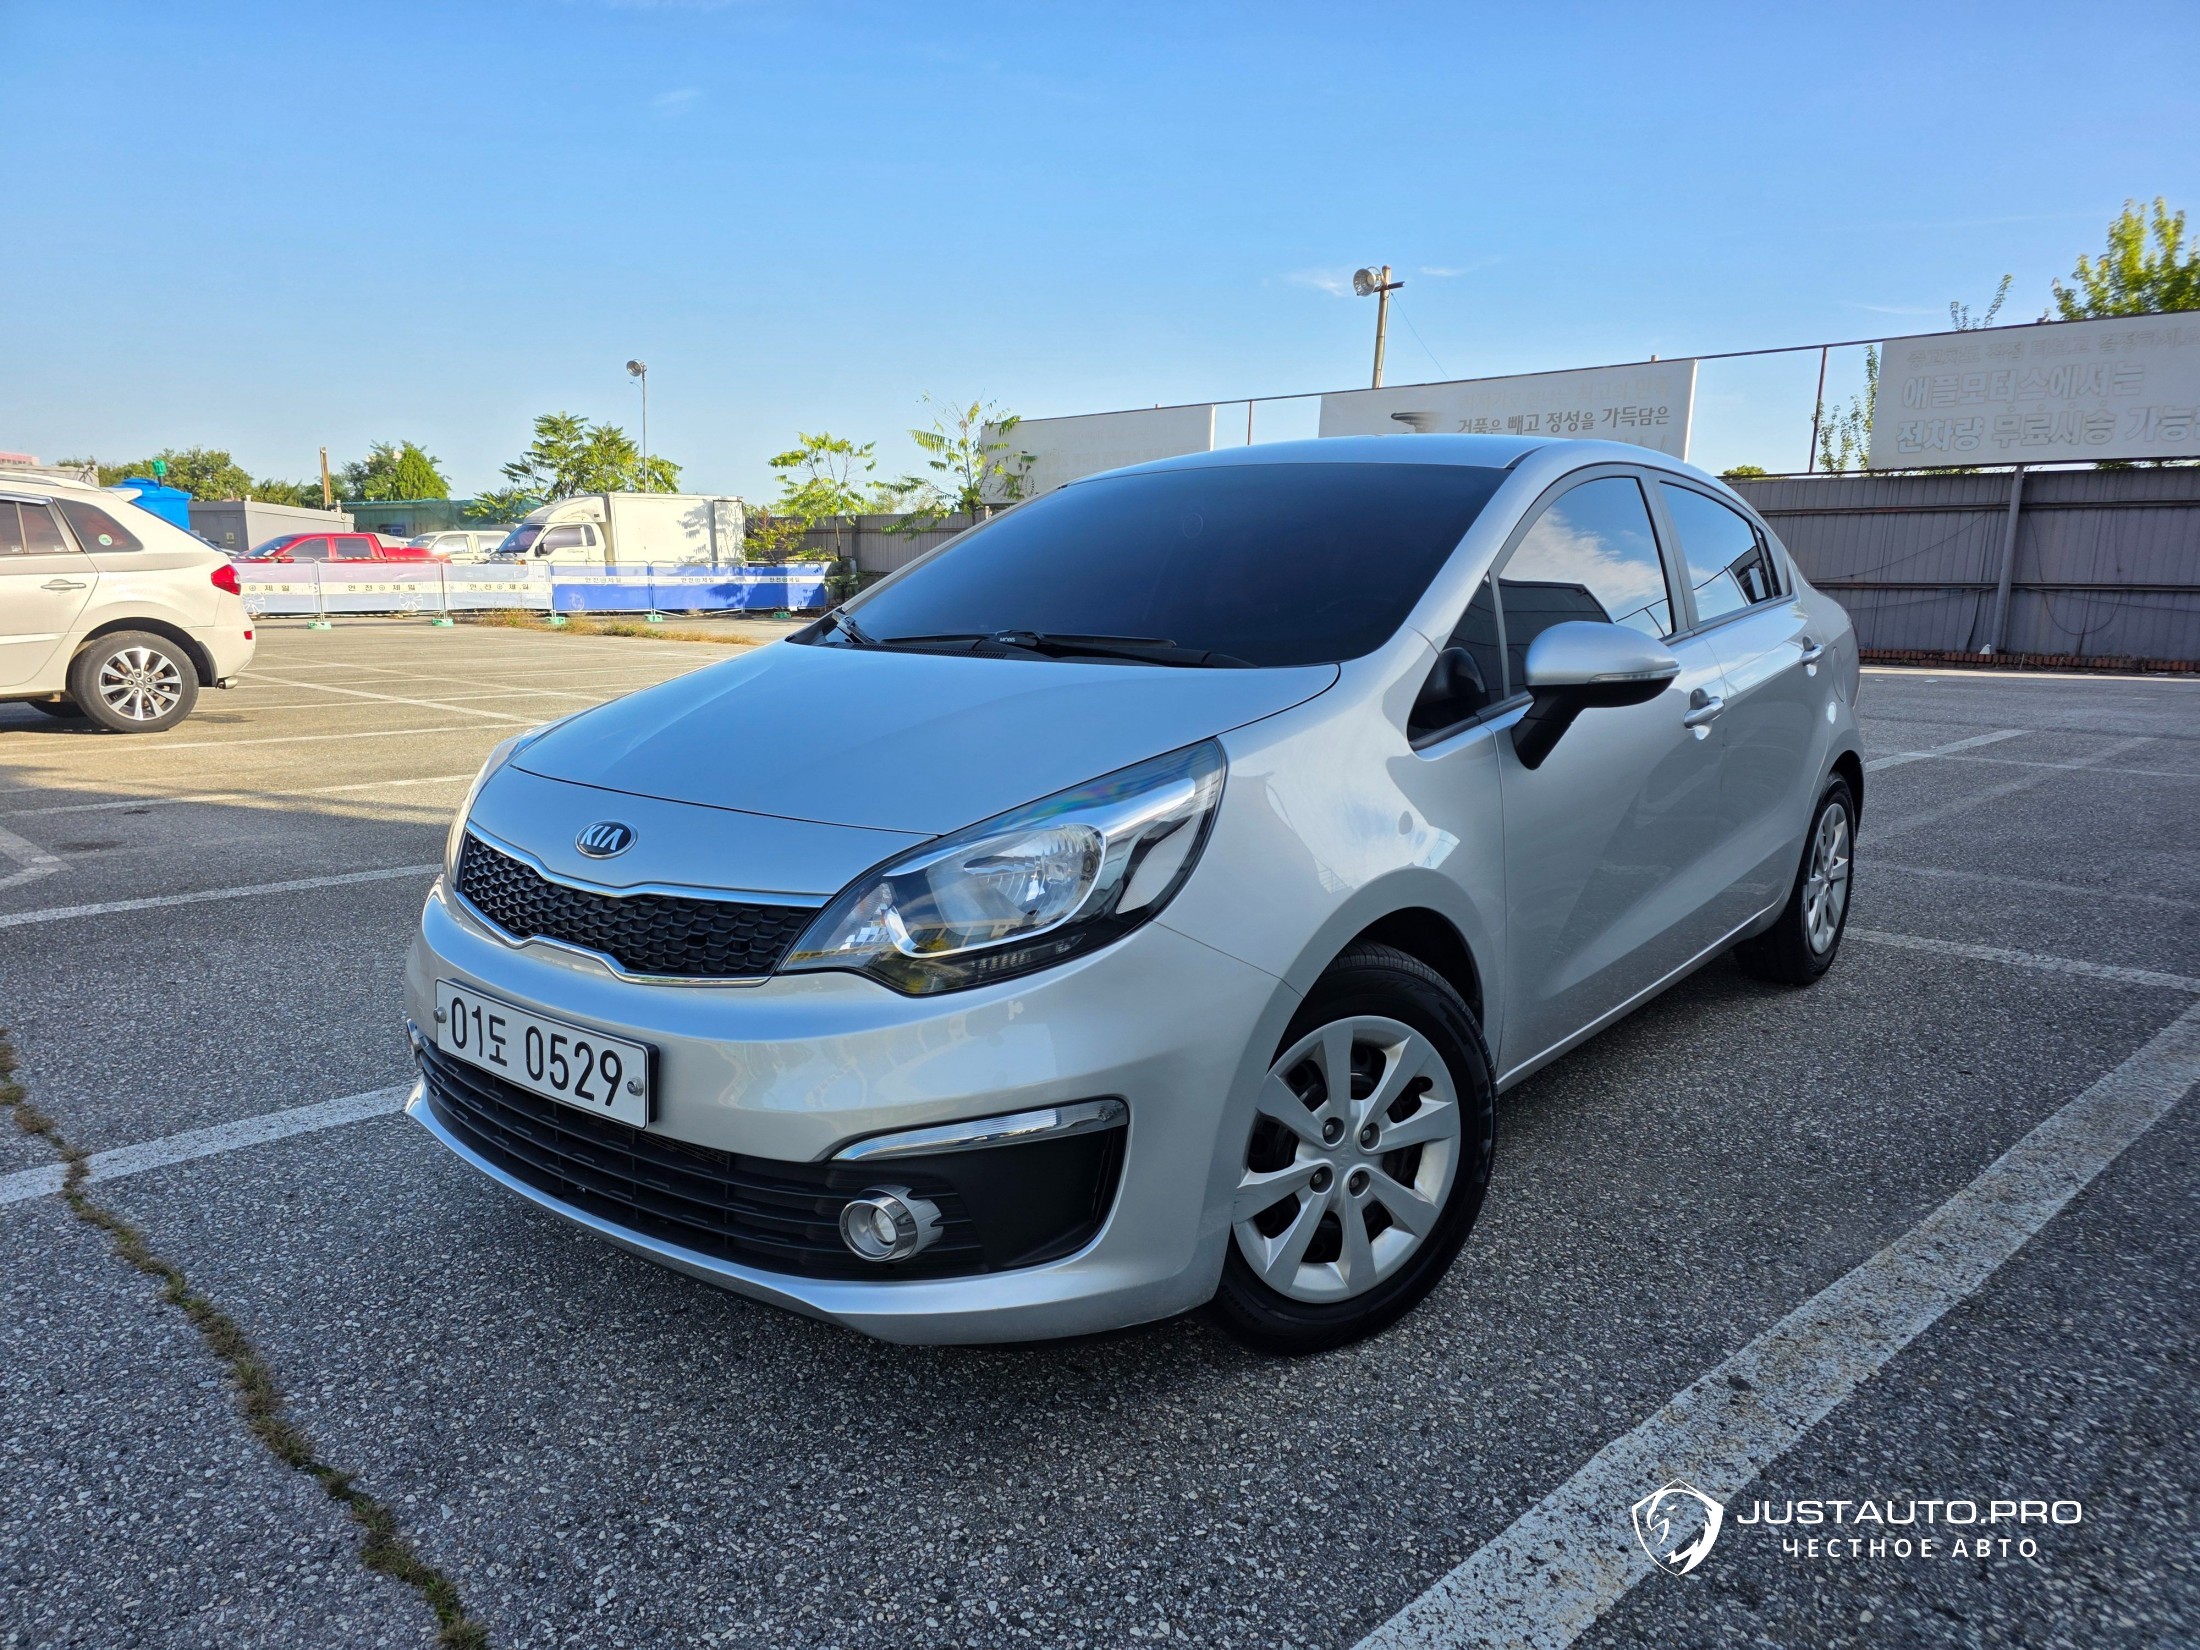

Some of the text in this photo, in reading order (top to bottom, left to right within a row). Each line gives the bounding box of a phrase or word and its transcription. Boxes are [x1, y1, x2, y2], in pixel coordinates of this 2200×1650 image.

[1902, 360, 2145, 410] 애플모터스에서는
[1457, 405, 1671, 436] 거품은 빼고 정성을 가득담은
[1895, 404, 2200, 455] 전차량 무료시승 가능
[580, 824, 624, 851] KIA
[451, 996, 623, 1107] 01도 0529
